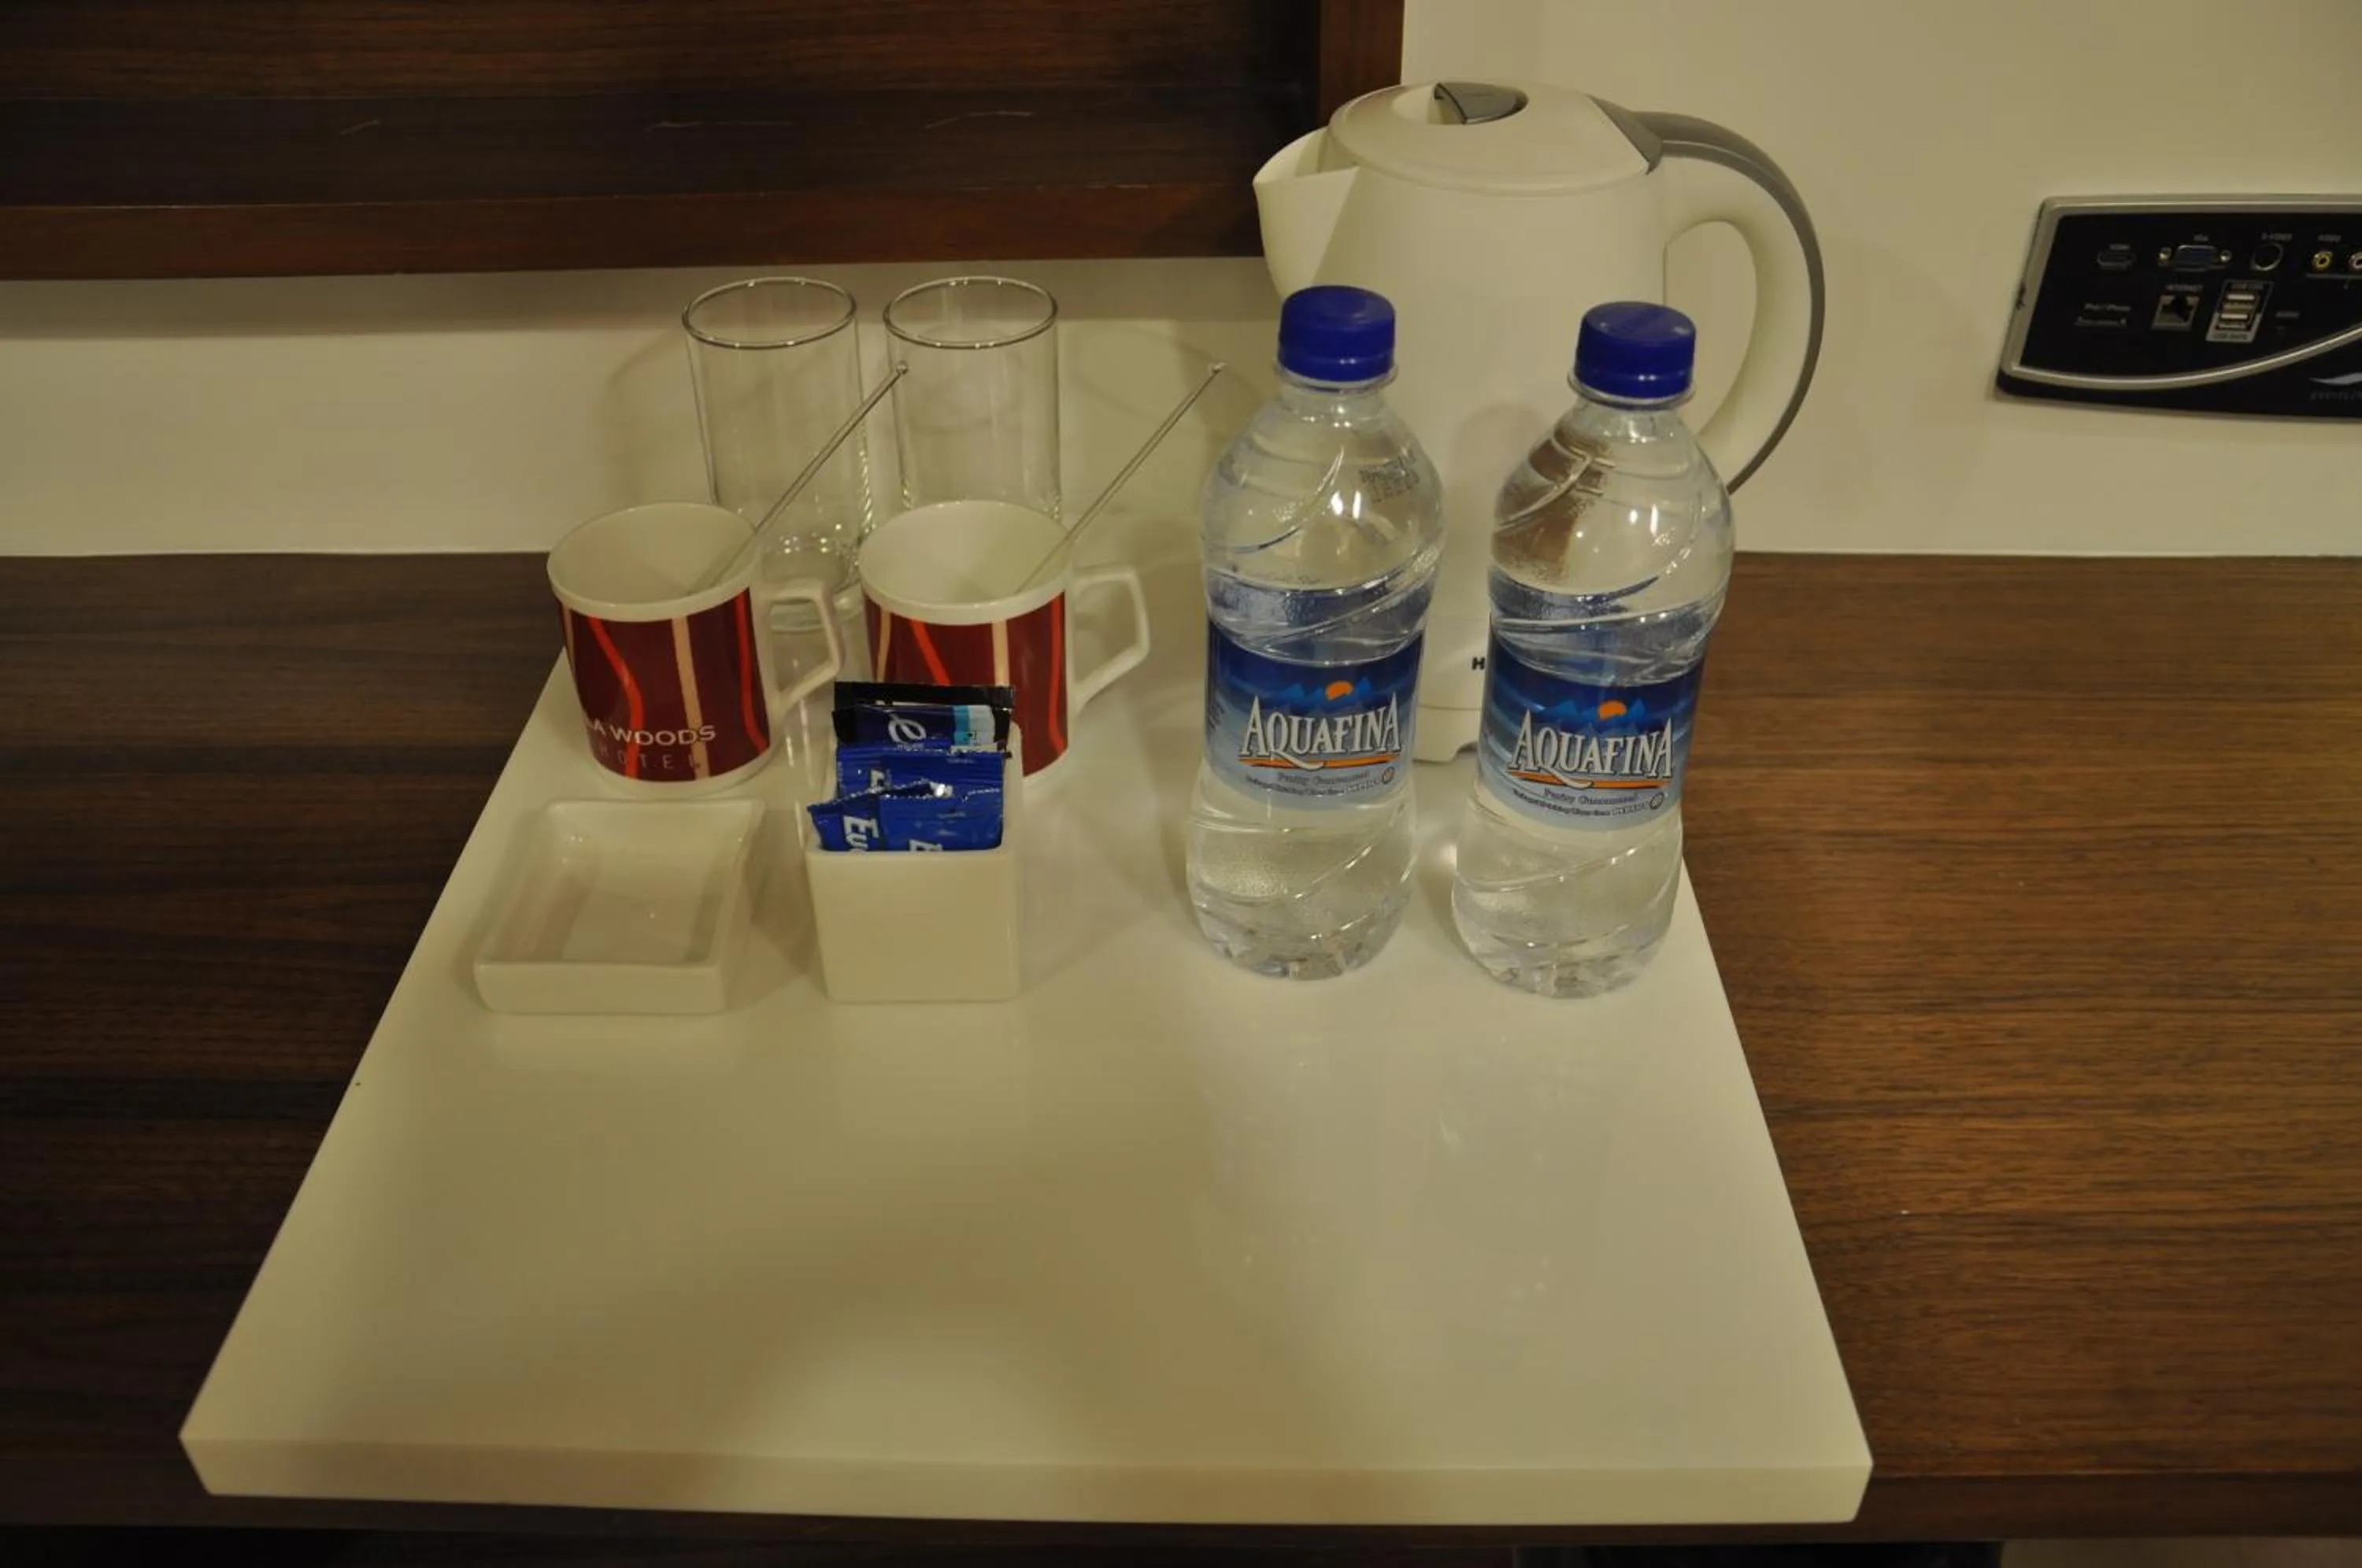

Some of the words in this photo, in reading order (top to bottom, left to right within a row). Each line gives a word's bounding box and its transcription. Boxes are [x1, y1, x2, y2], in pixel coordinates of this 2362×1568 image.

[609, 724, 716, 746] WOODS
[1239, 692, 1401, 769] AQUAFINA
[1508, 708, 1674, 788] AQUAFINA
